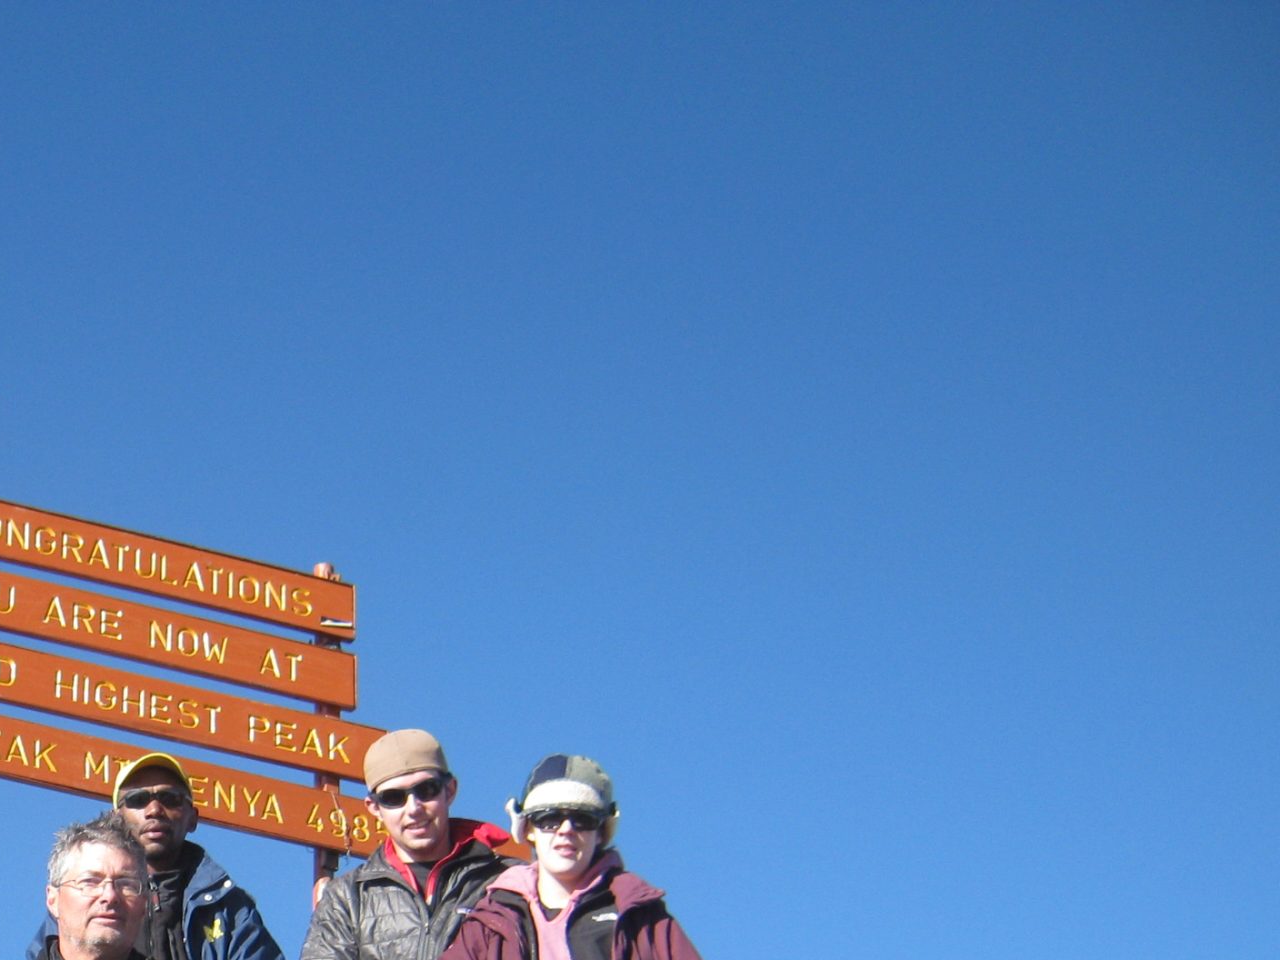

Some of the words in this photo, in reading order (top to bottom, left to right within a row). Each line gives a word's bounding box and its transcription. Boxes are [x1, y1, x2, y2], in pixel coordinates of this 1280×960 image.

[42, 595, 124, 641] ARE
[149, 619, 228, 664] NOW
[260, 647, 303, 683] AT
[54, 668, 221, 735] HIGHEST
[247, 713, 351, 764] PEAK
[188, 776, 284, 824] ENYA
